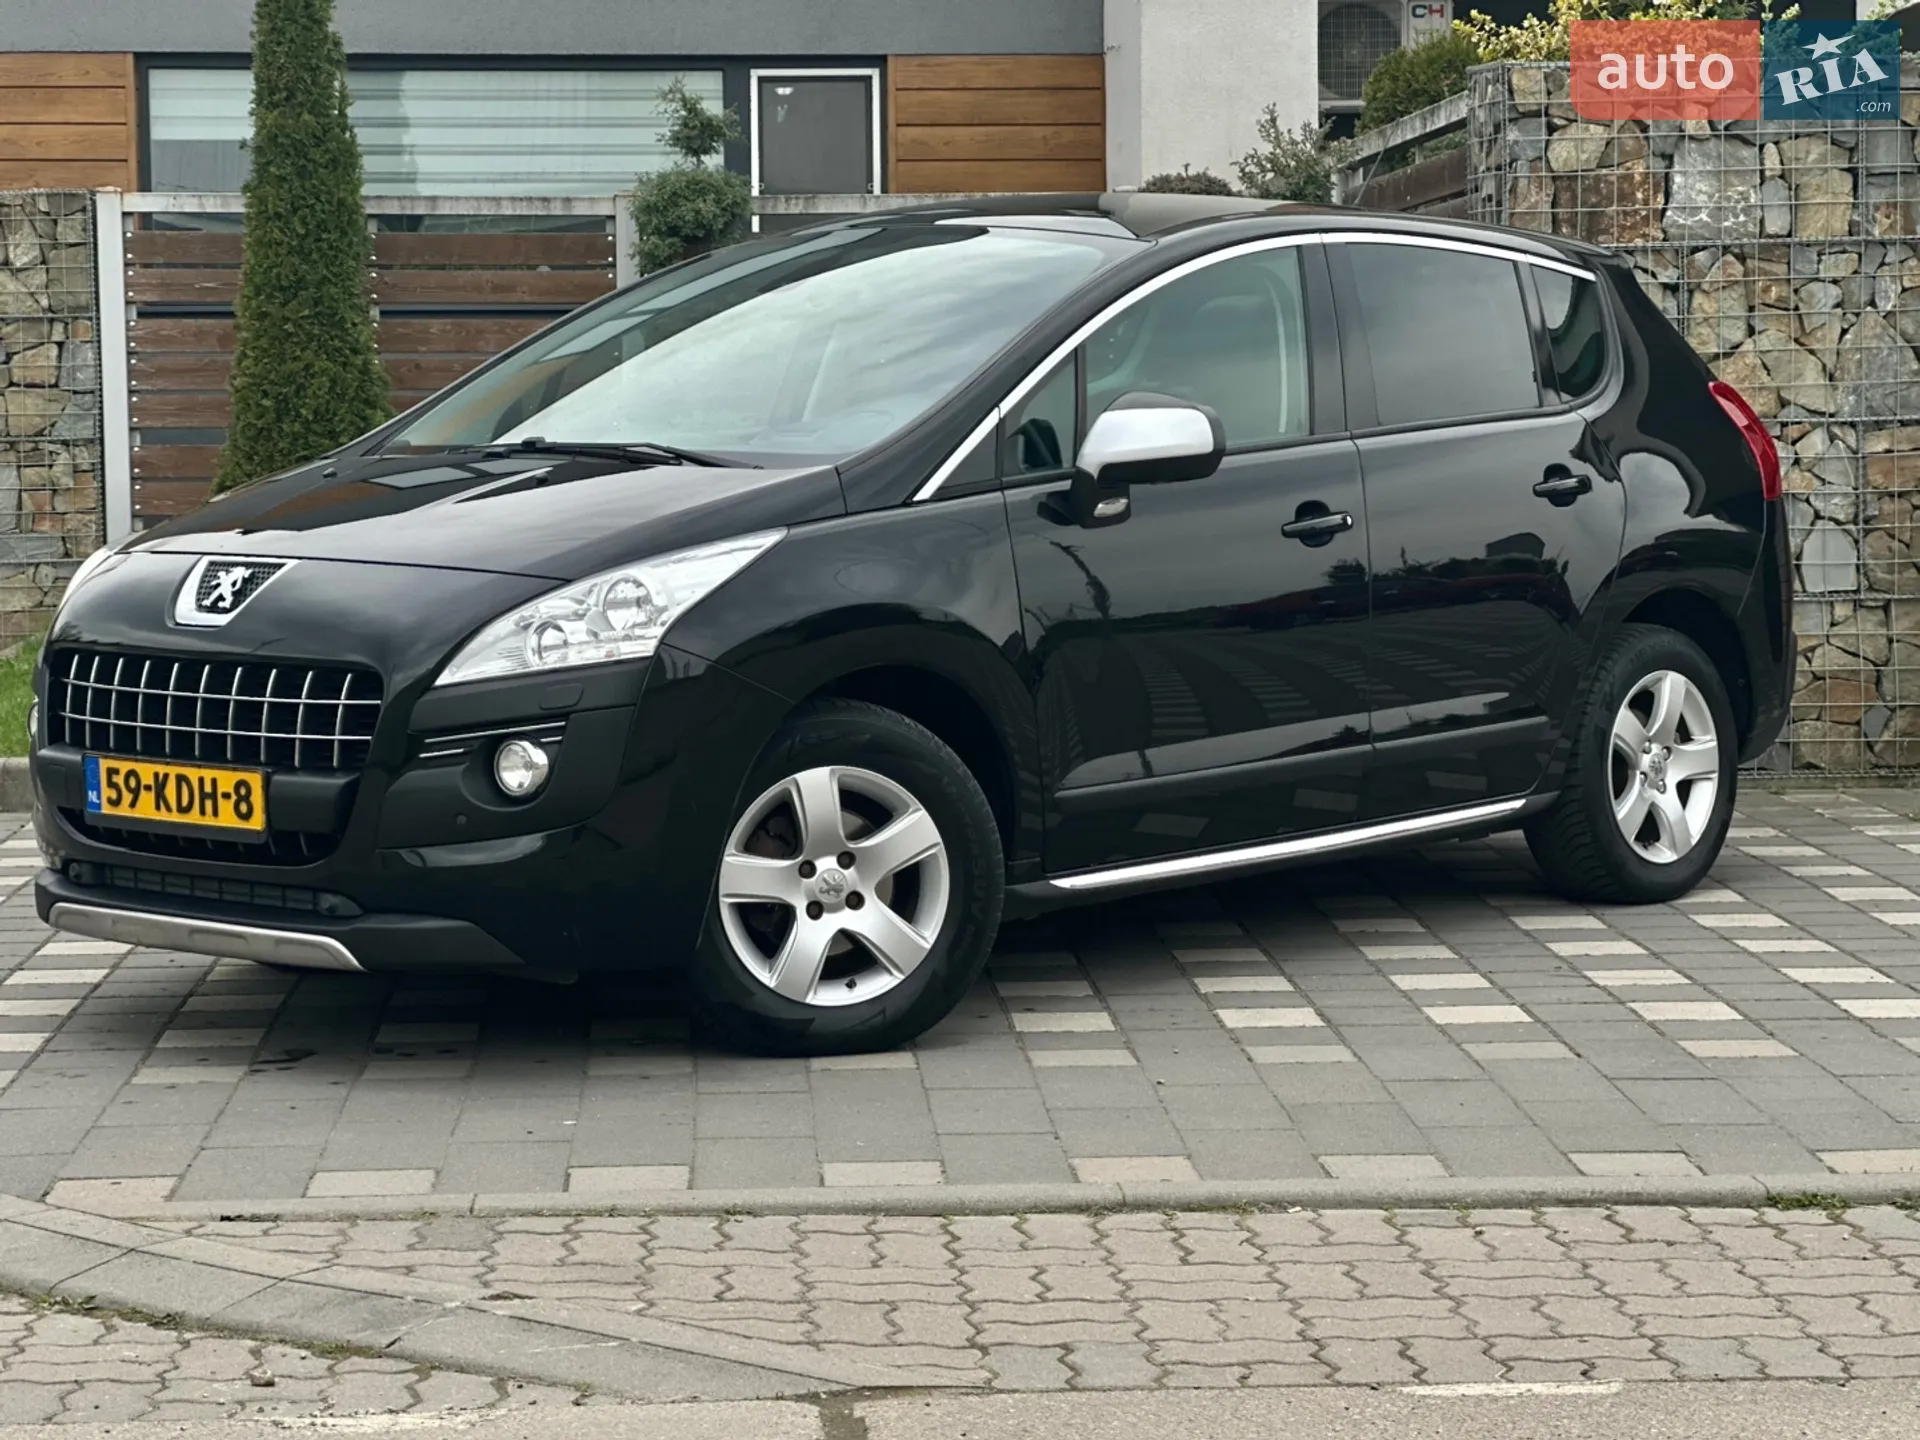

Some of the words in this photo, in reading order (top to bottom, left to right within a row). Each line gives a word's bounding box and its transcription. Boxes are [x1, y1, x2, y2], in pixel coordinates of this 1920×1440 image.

[1411, 4, 1444, 18] CH
[88, 790, 100, 803] NL
[105, 766, 254, 822] 59-KDH-8
